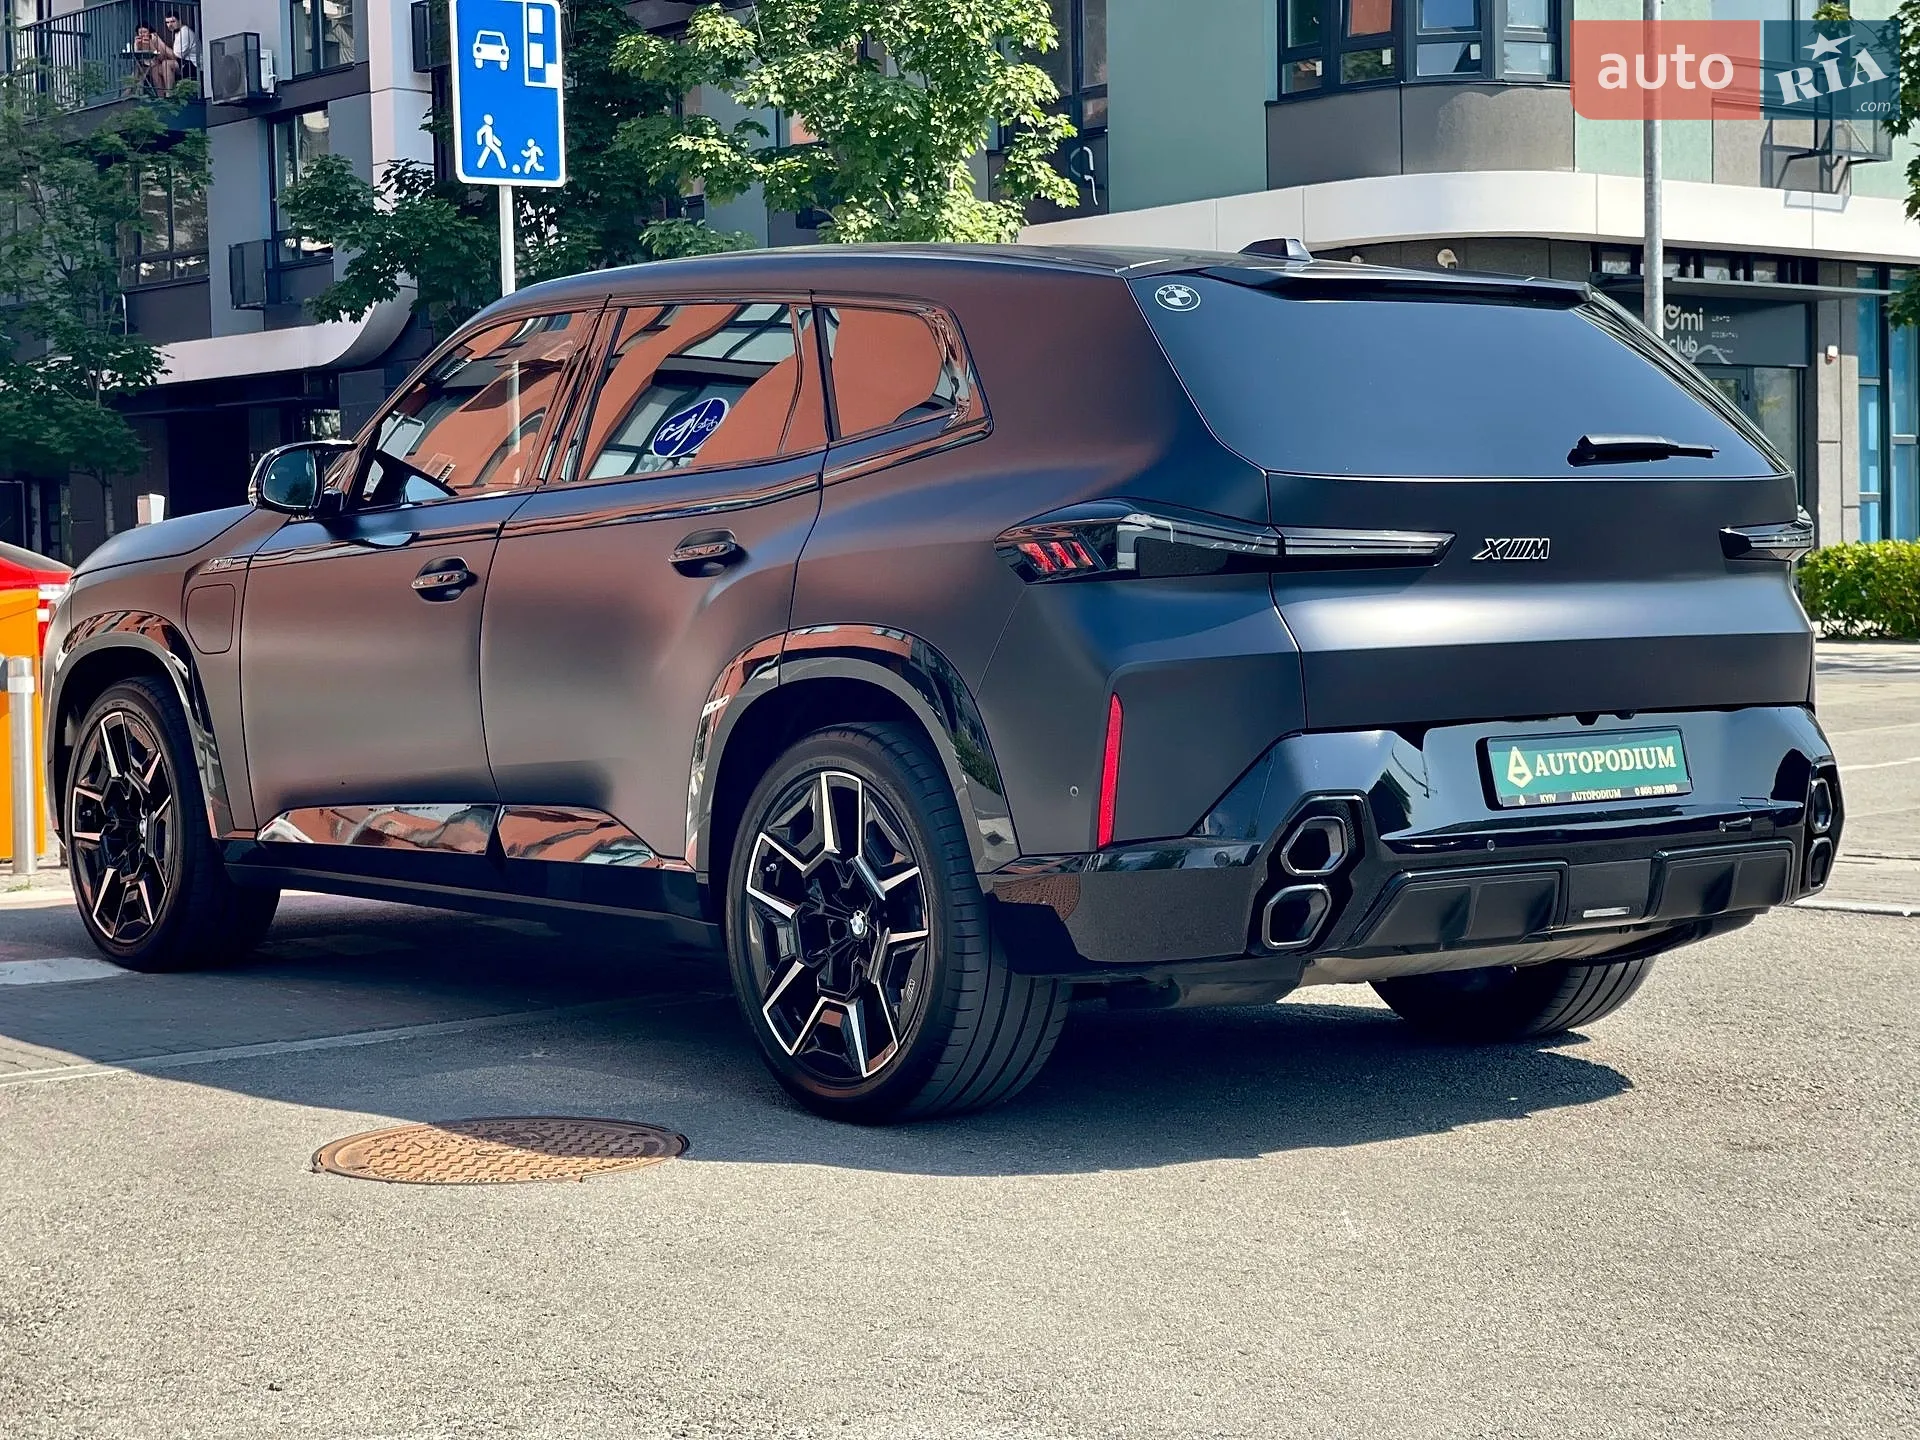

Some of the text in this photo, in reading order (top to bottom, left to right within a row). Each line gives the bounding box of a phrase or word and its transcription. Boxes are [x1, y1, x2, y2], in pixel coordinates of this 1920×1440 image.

[1535, 746, 1677, 777] AUTOPODIUM
[1539, 793, 1557, 804] KYIV
[1571, 789, 1621, 802] AUTOPODIUM
